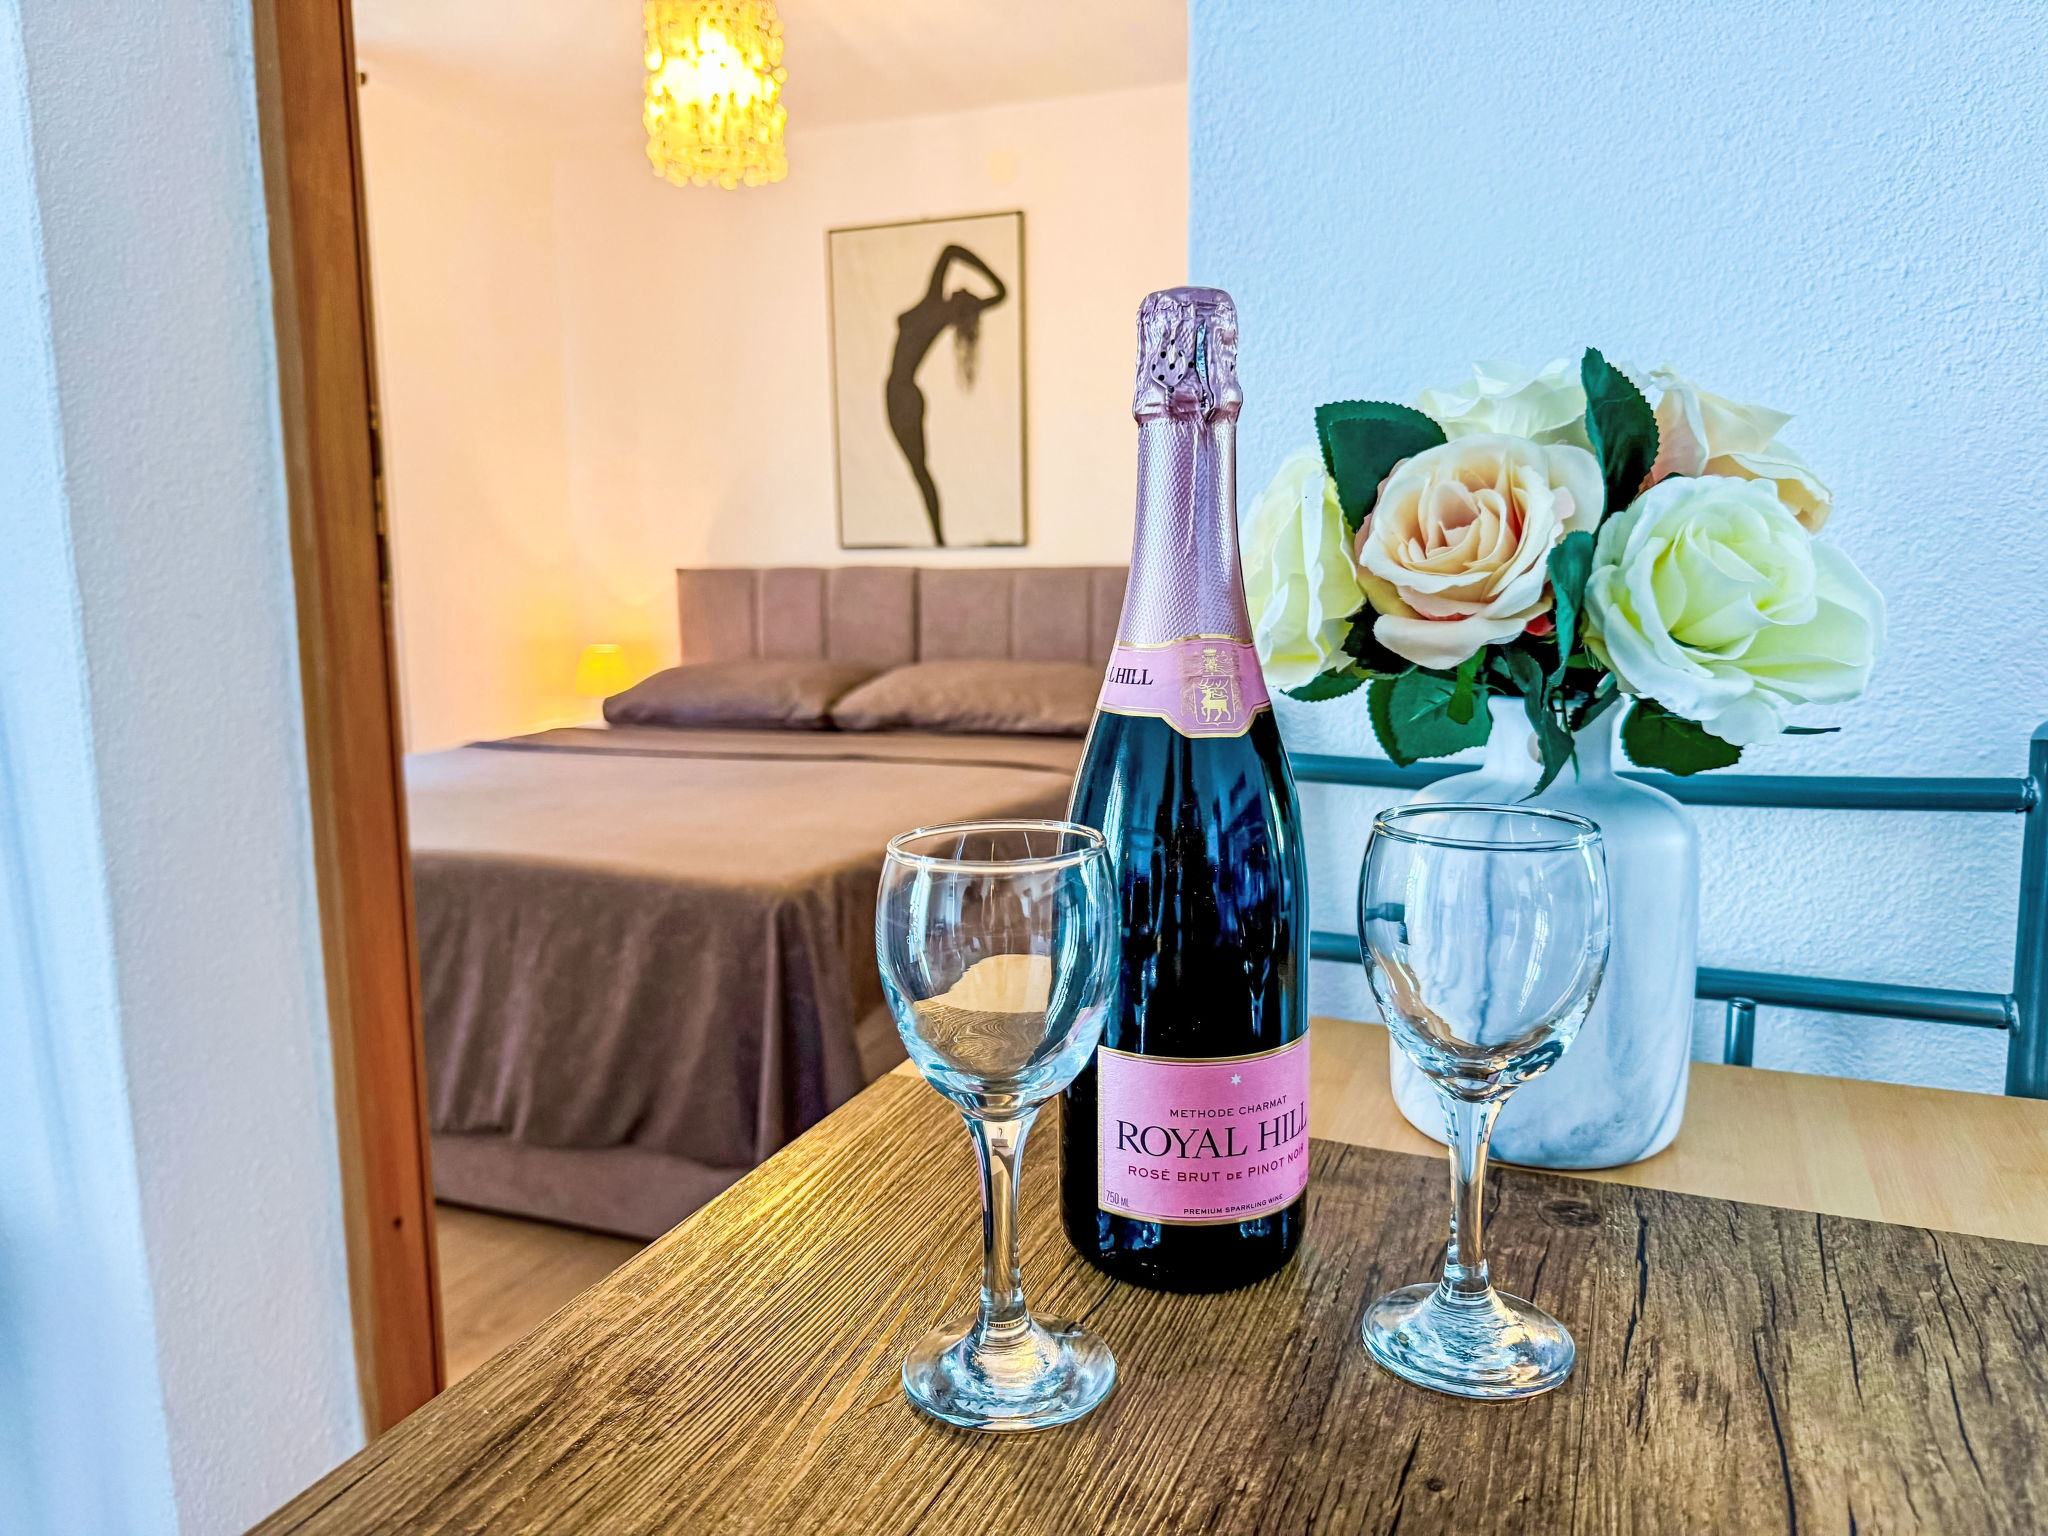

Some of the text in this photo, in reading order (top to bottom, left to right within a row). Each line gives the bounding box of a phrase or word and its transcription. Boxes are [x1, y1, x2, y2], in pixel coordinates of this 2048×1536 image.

[1115, 667, 1154, 685] HILL
[1169, 1095, 1286, 1118] METHODE CHARMAT
[1116, 1101, 1307, 1159] ROYAL HILL
[1128, 1165, 1170, 1181] ROSÉ
[1177, 1171, 1220, 1182] BRUT
[1248, 1158, 1284, 1178] PINOT
[1105, 1189, 1120, 1205] 750
[1225, 1200, 1267, 1213] SPARKLING
[1268, 1193, 1284, 1204] WINE
